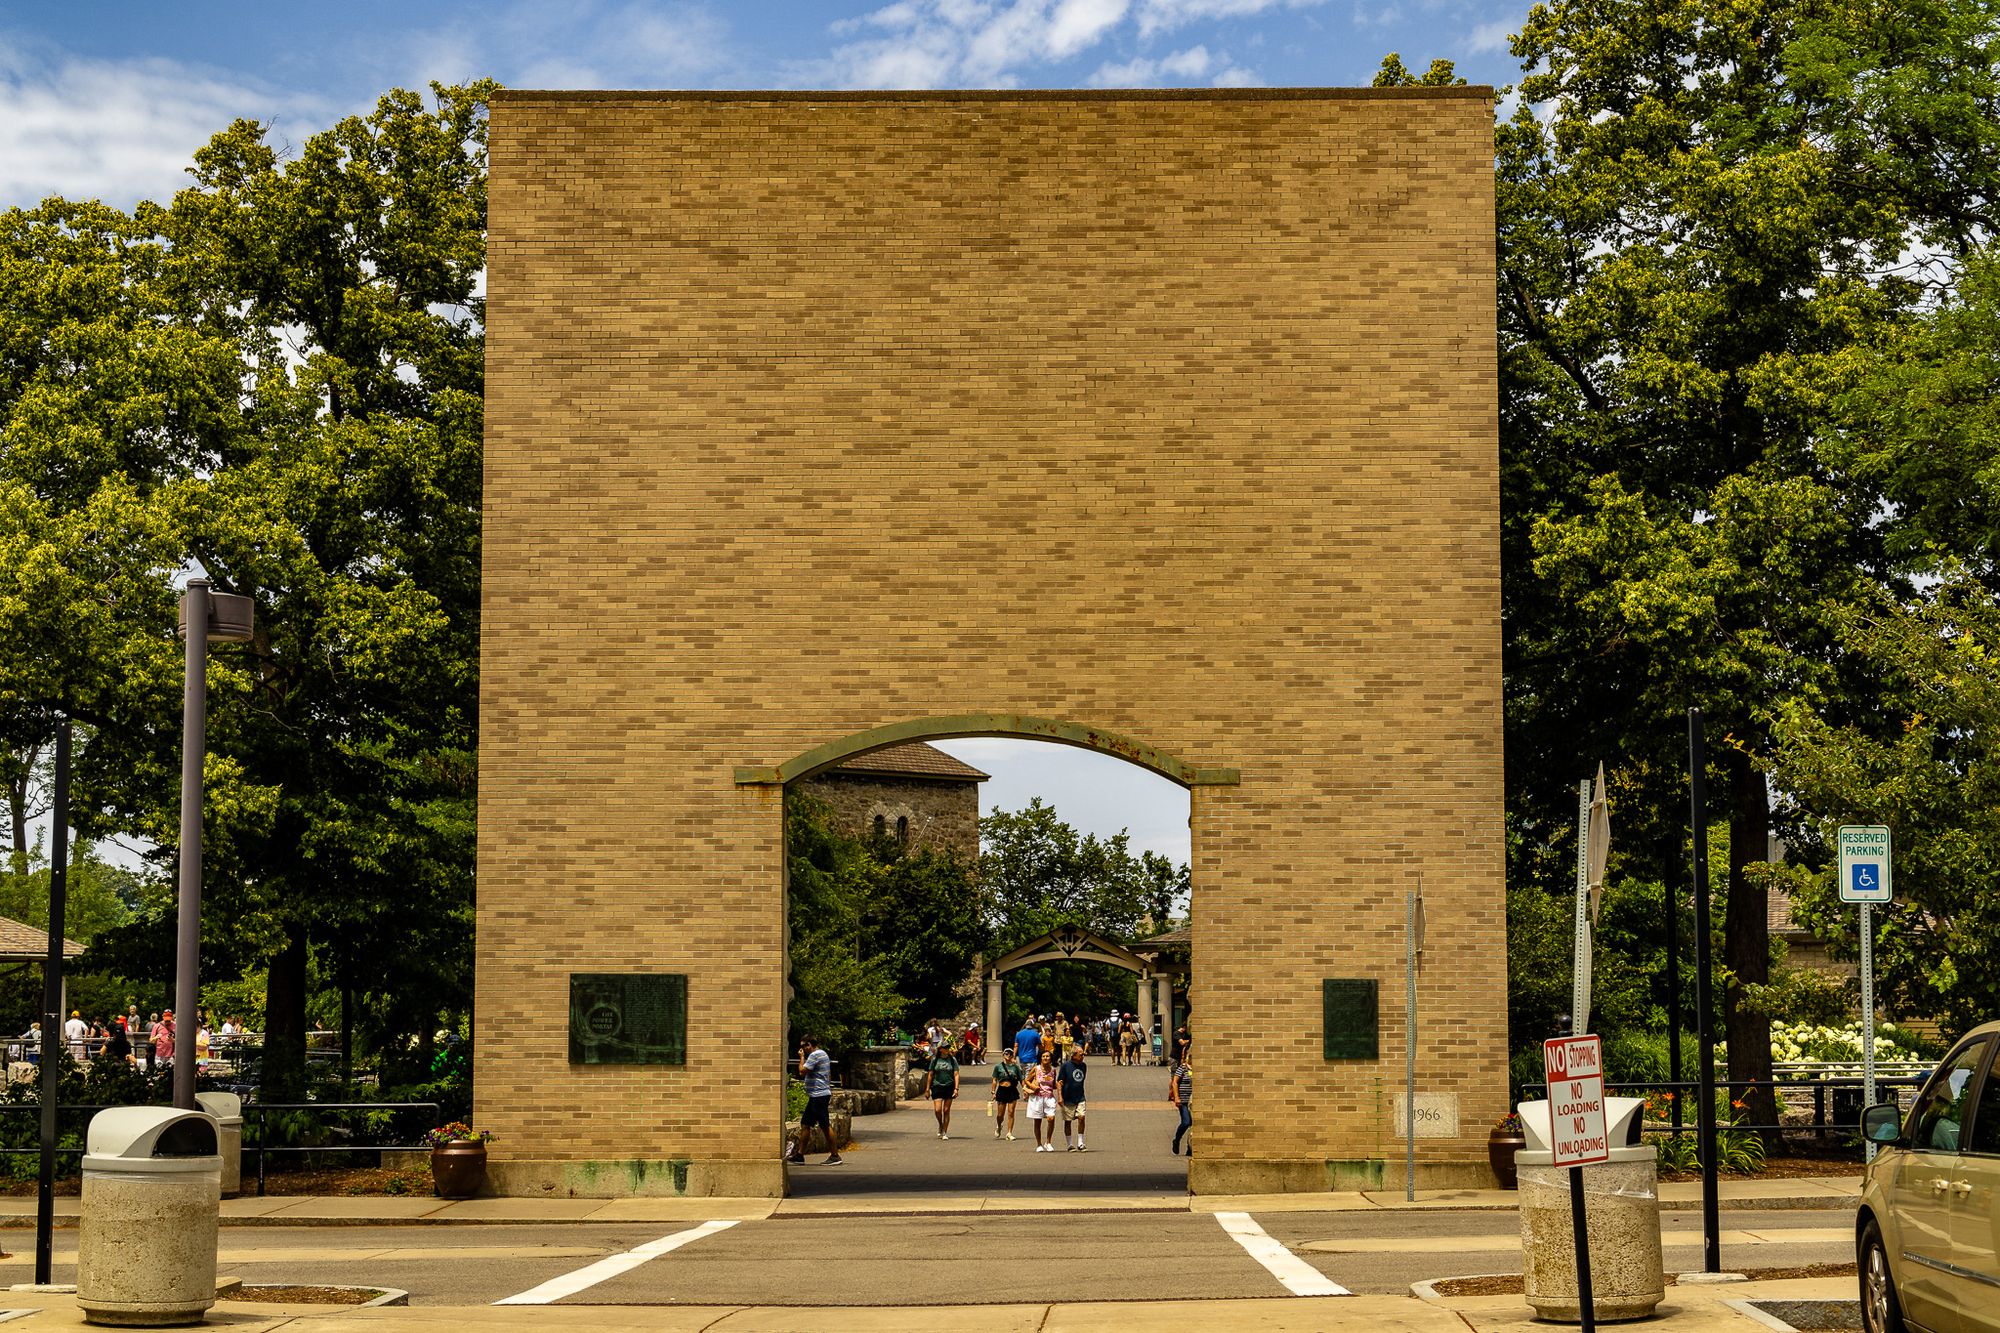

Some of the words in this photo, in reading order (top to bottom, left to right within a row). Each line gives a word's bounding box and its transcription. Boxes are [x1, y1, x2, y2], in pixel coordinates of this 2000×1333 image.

[1842, 833, 1887, 843] RESERVED
[1845, 846, 1884, 856] PARKING
[1547, 1045, 1565, 1073] NO
[1568, 1045, 1596, 1068] STOPPING
[1570, 1082, 1583, 1099] NO
[1413, 1108, 1441, 1122] 1966
[1557, 1101, 1599, 1116] LOADING
[1573, 1117, 1586, 1134] NO
[1558, 1137, 1604, 1155] UNLOADING
